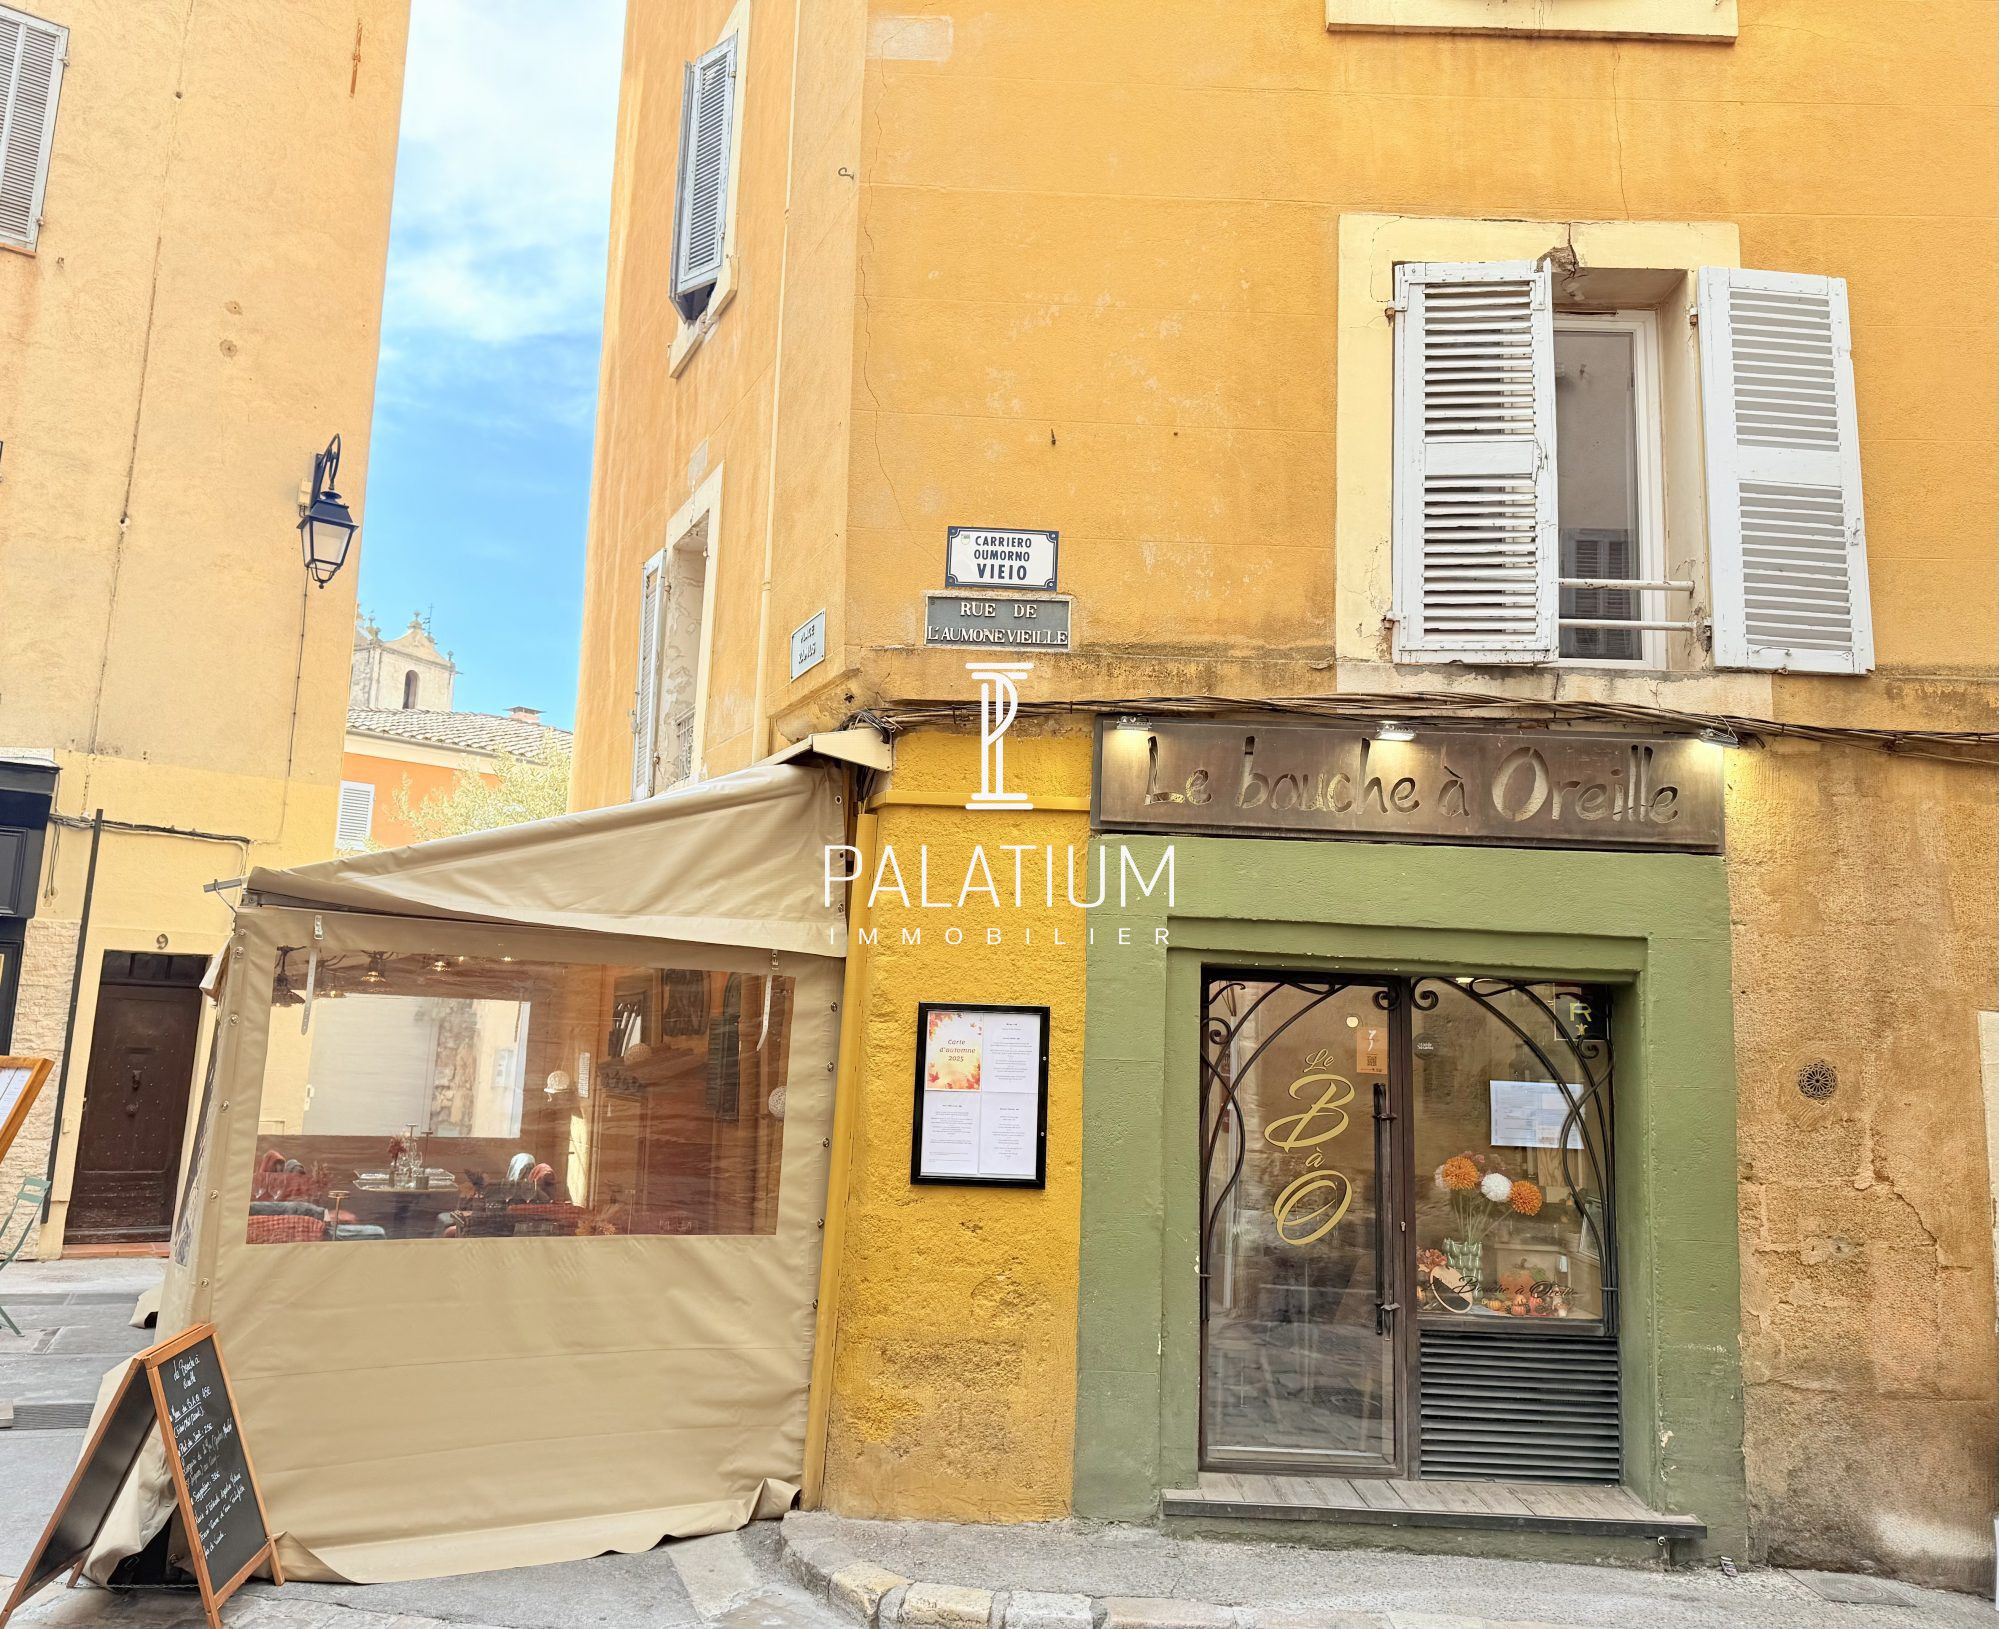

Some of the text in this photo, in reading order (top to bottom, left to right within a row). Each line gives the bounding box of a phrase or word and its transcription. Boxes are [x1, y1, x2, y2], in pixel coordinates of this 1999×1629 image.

[975, 535, 1032, 549] CARRIERO
[973, 549, 1030, 562] OUMORNO
[976, 563, 1027, 581] VIEIO
[960, 602, 1037, 618] RUE DE
[1144, 735, 1679, 824] Le bouche à Oreille
[156, 933, 168, 950] 9
[939, 1046, 976, 1054] d'automne
[1304, 1048, 1335, 1073] Le
[1264, 1073, 1355, 1153] B
[1305, 1146, 1326, 1168] à
[1273, 1169, 1352, 1246] O
